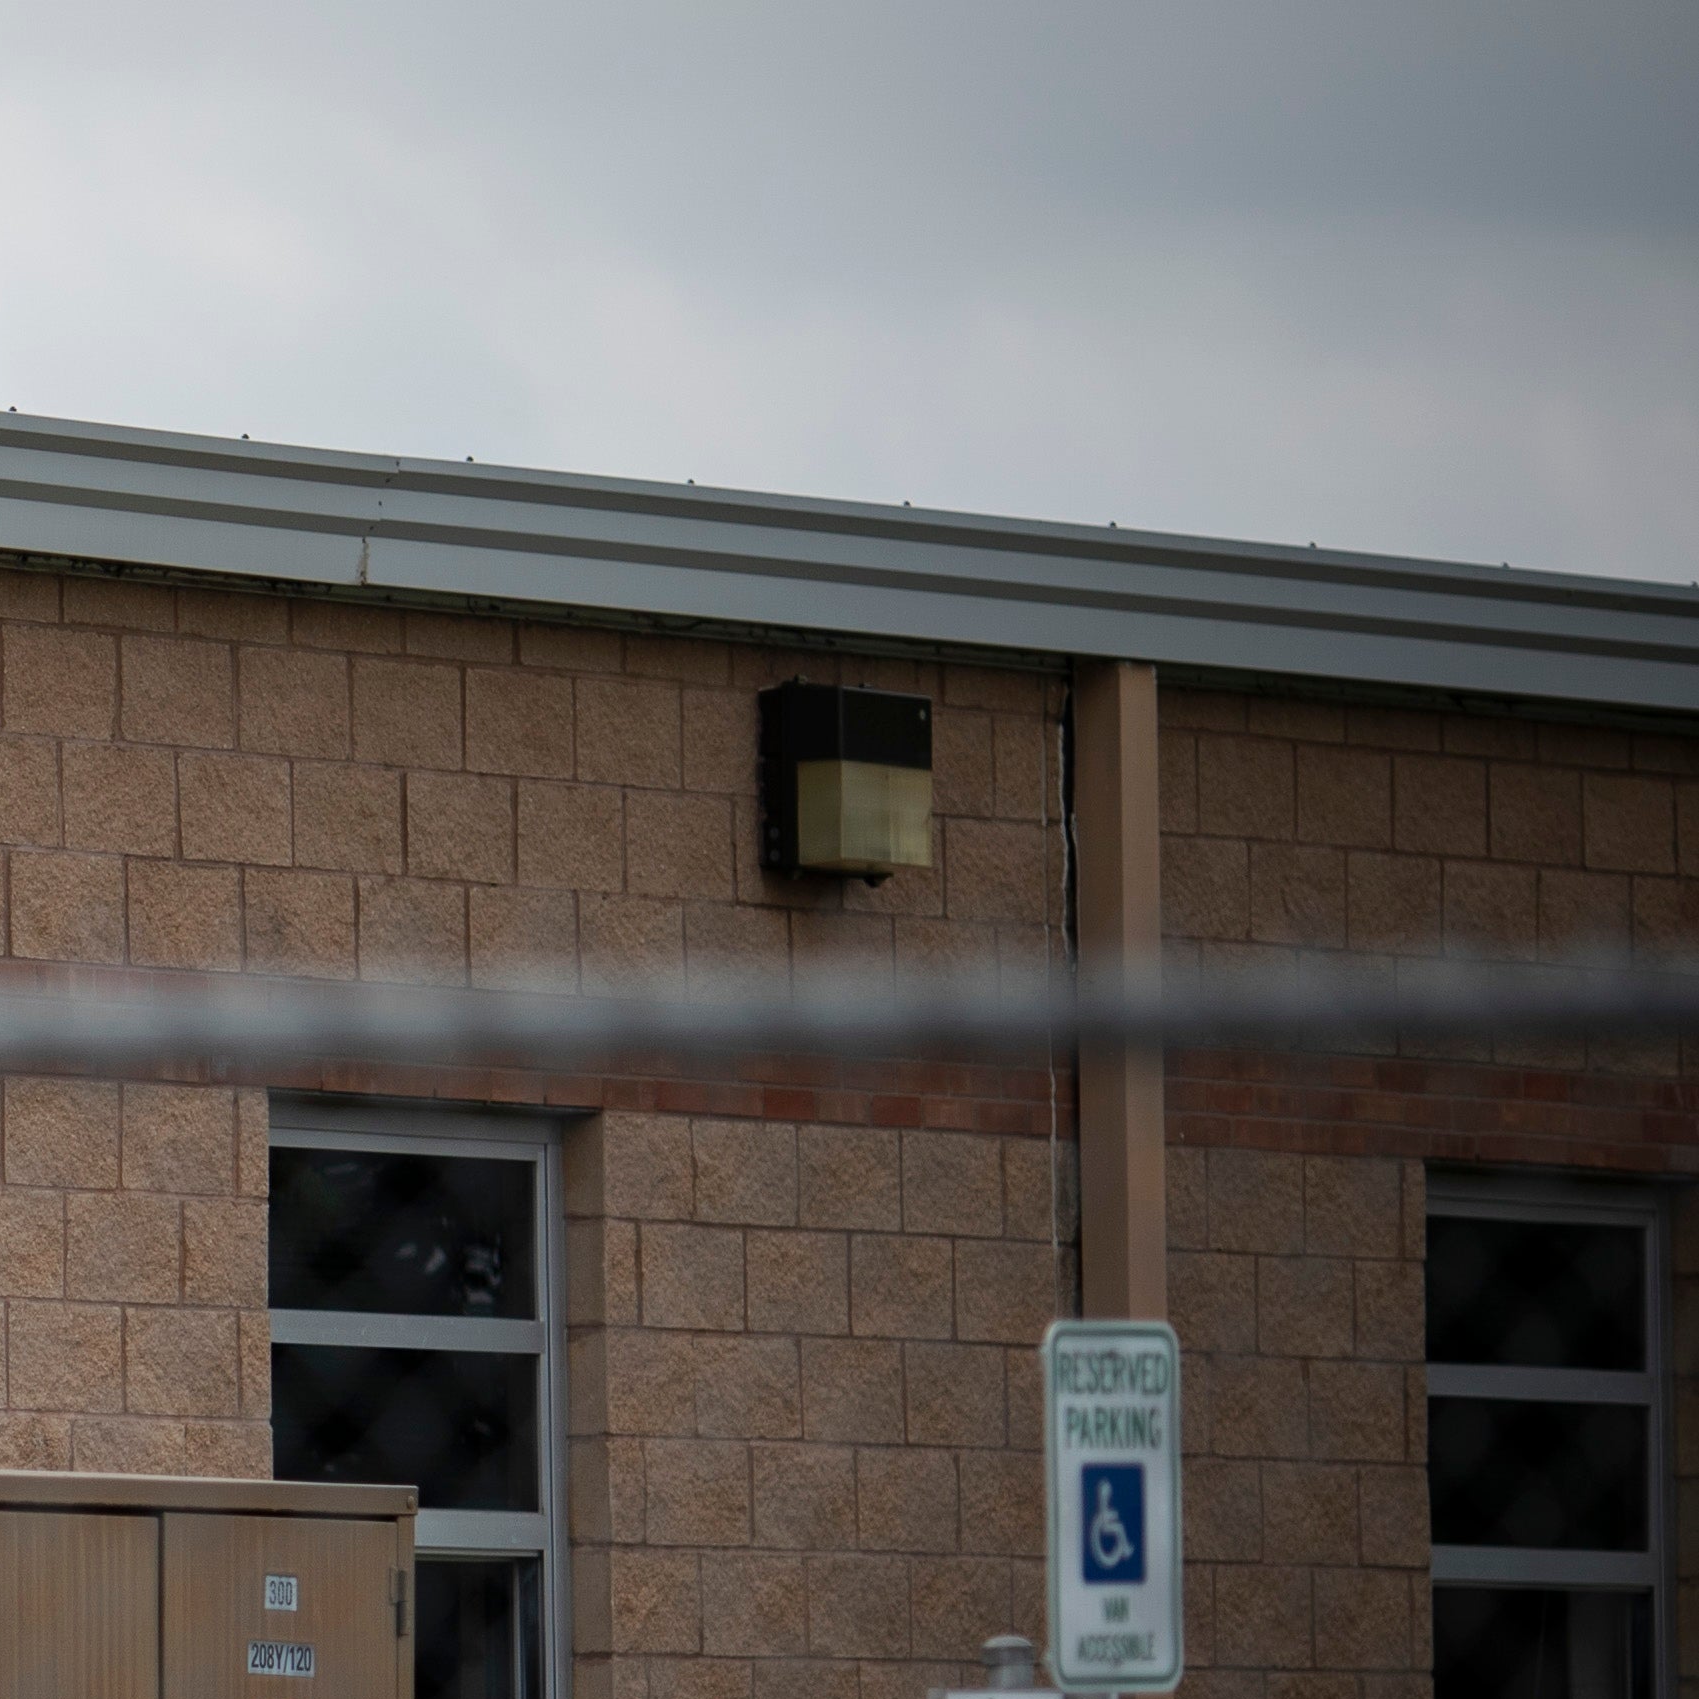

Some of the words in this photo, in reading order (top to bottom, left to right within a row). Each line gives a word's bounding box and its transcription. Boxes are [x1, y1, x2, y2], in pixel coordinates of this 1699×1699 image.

[1059, 1350, 1169, 1394] RESERVED
[1066, 1406, 1161, 1450] PARKING
[269, 1580, 293, 1606] 300
[251, 1643, 312, 1673] 208Y/120
